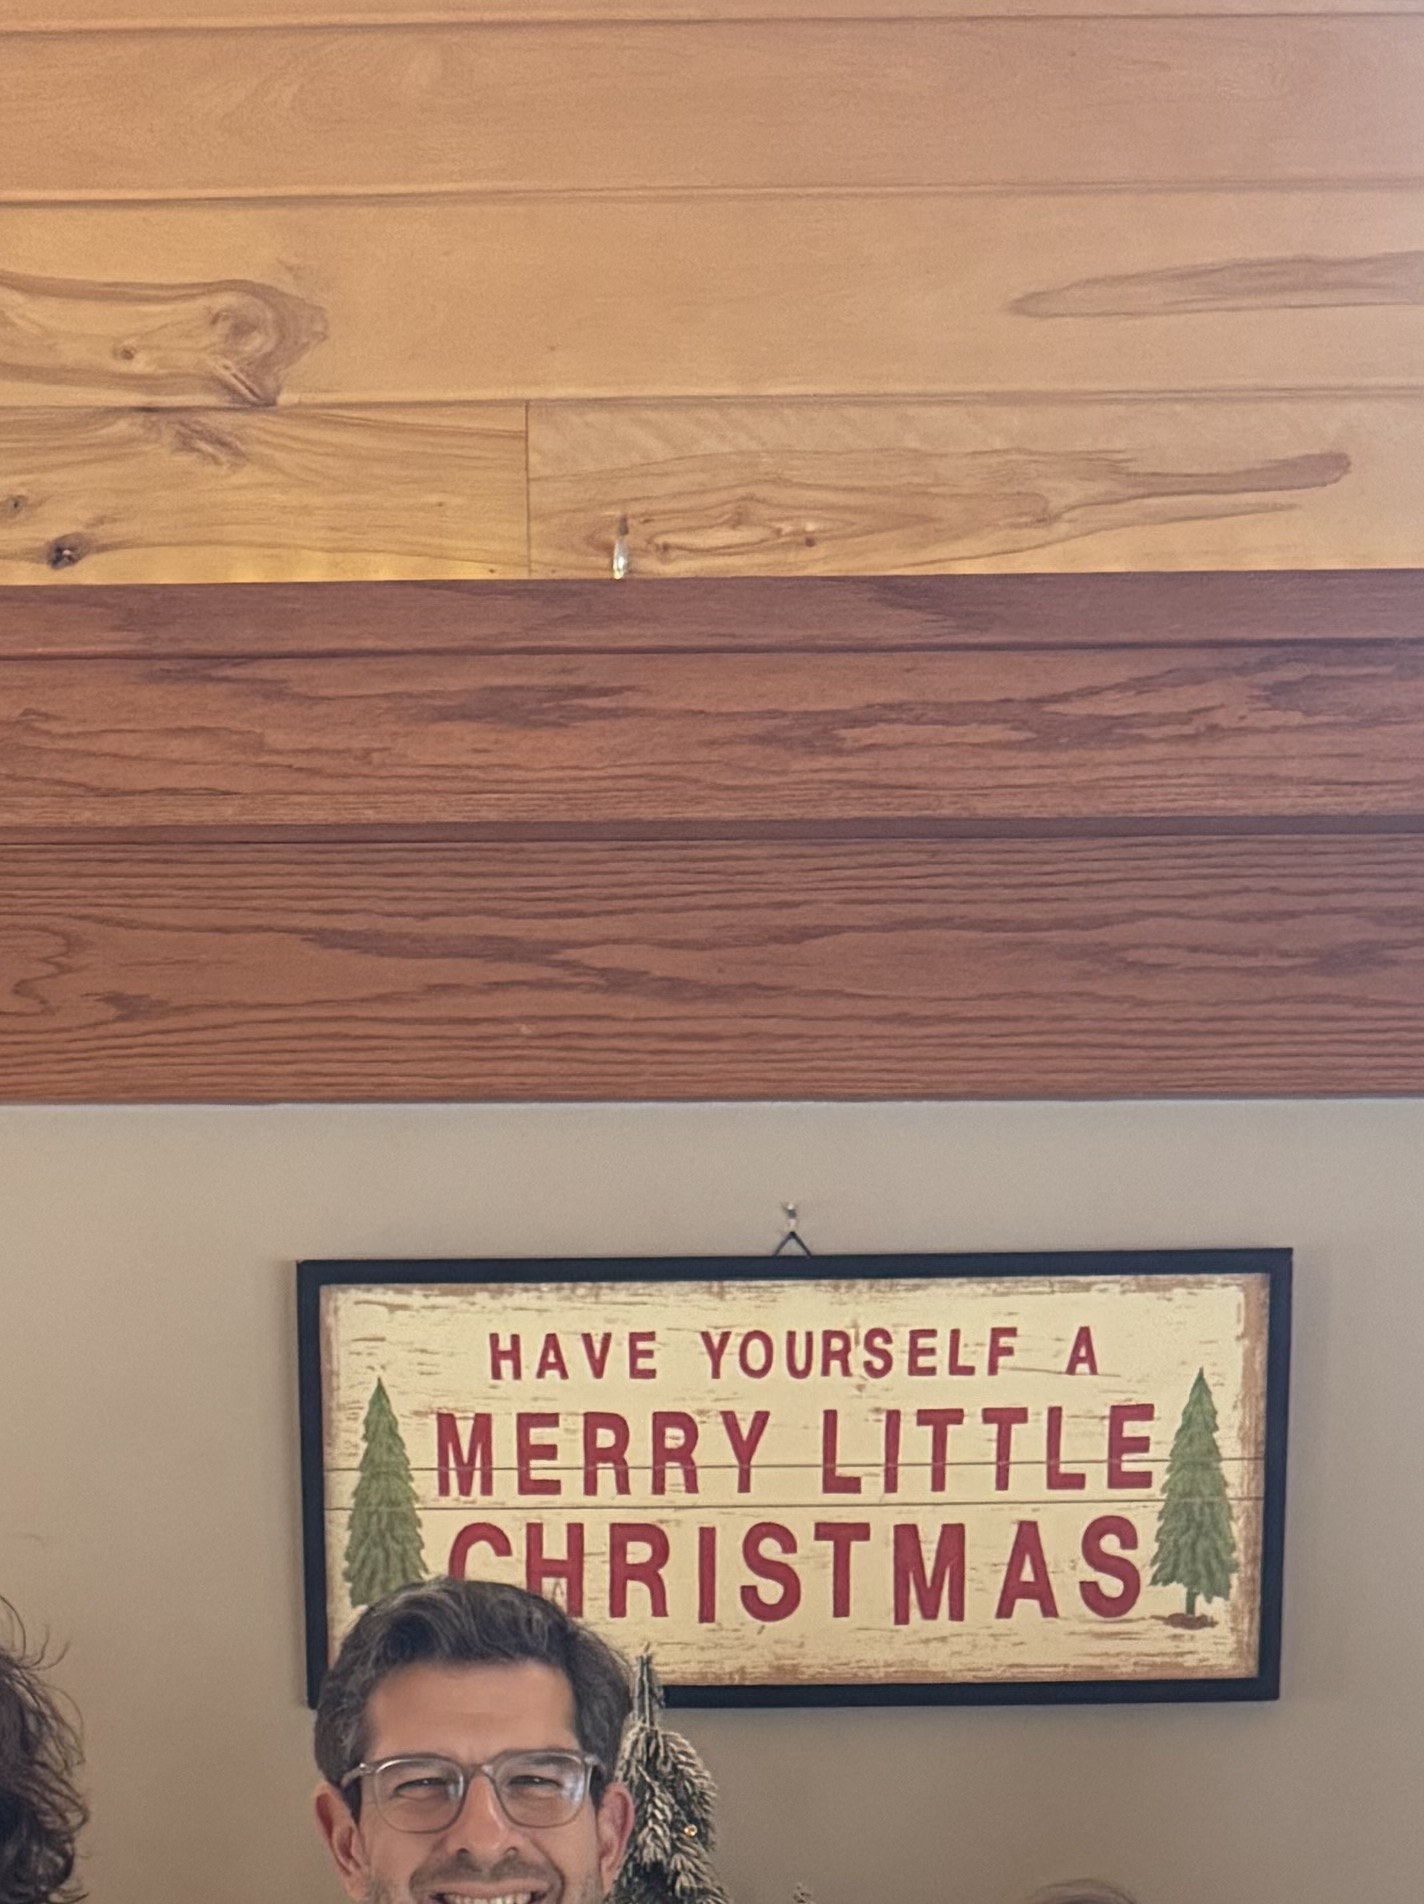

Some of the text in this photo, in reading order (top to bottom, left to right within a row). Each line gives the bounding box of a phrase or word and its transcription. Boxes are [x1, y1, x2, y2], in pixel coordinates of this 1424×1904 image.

[489, 1325, 1098, 1381] HAVE YOURSELF A
[435, 1403, 1156, 1497] MERRY LITTLE
